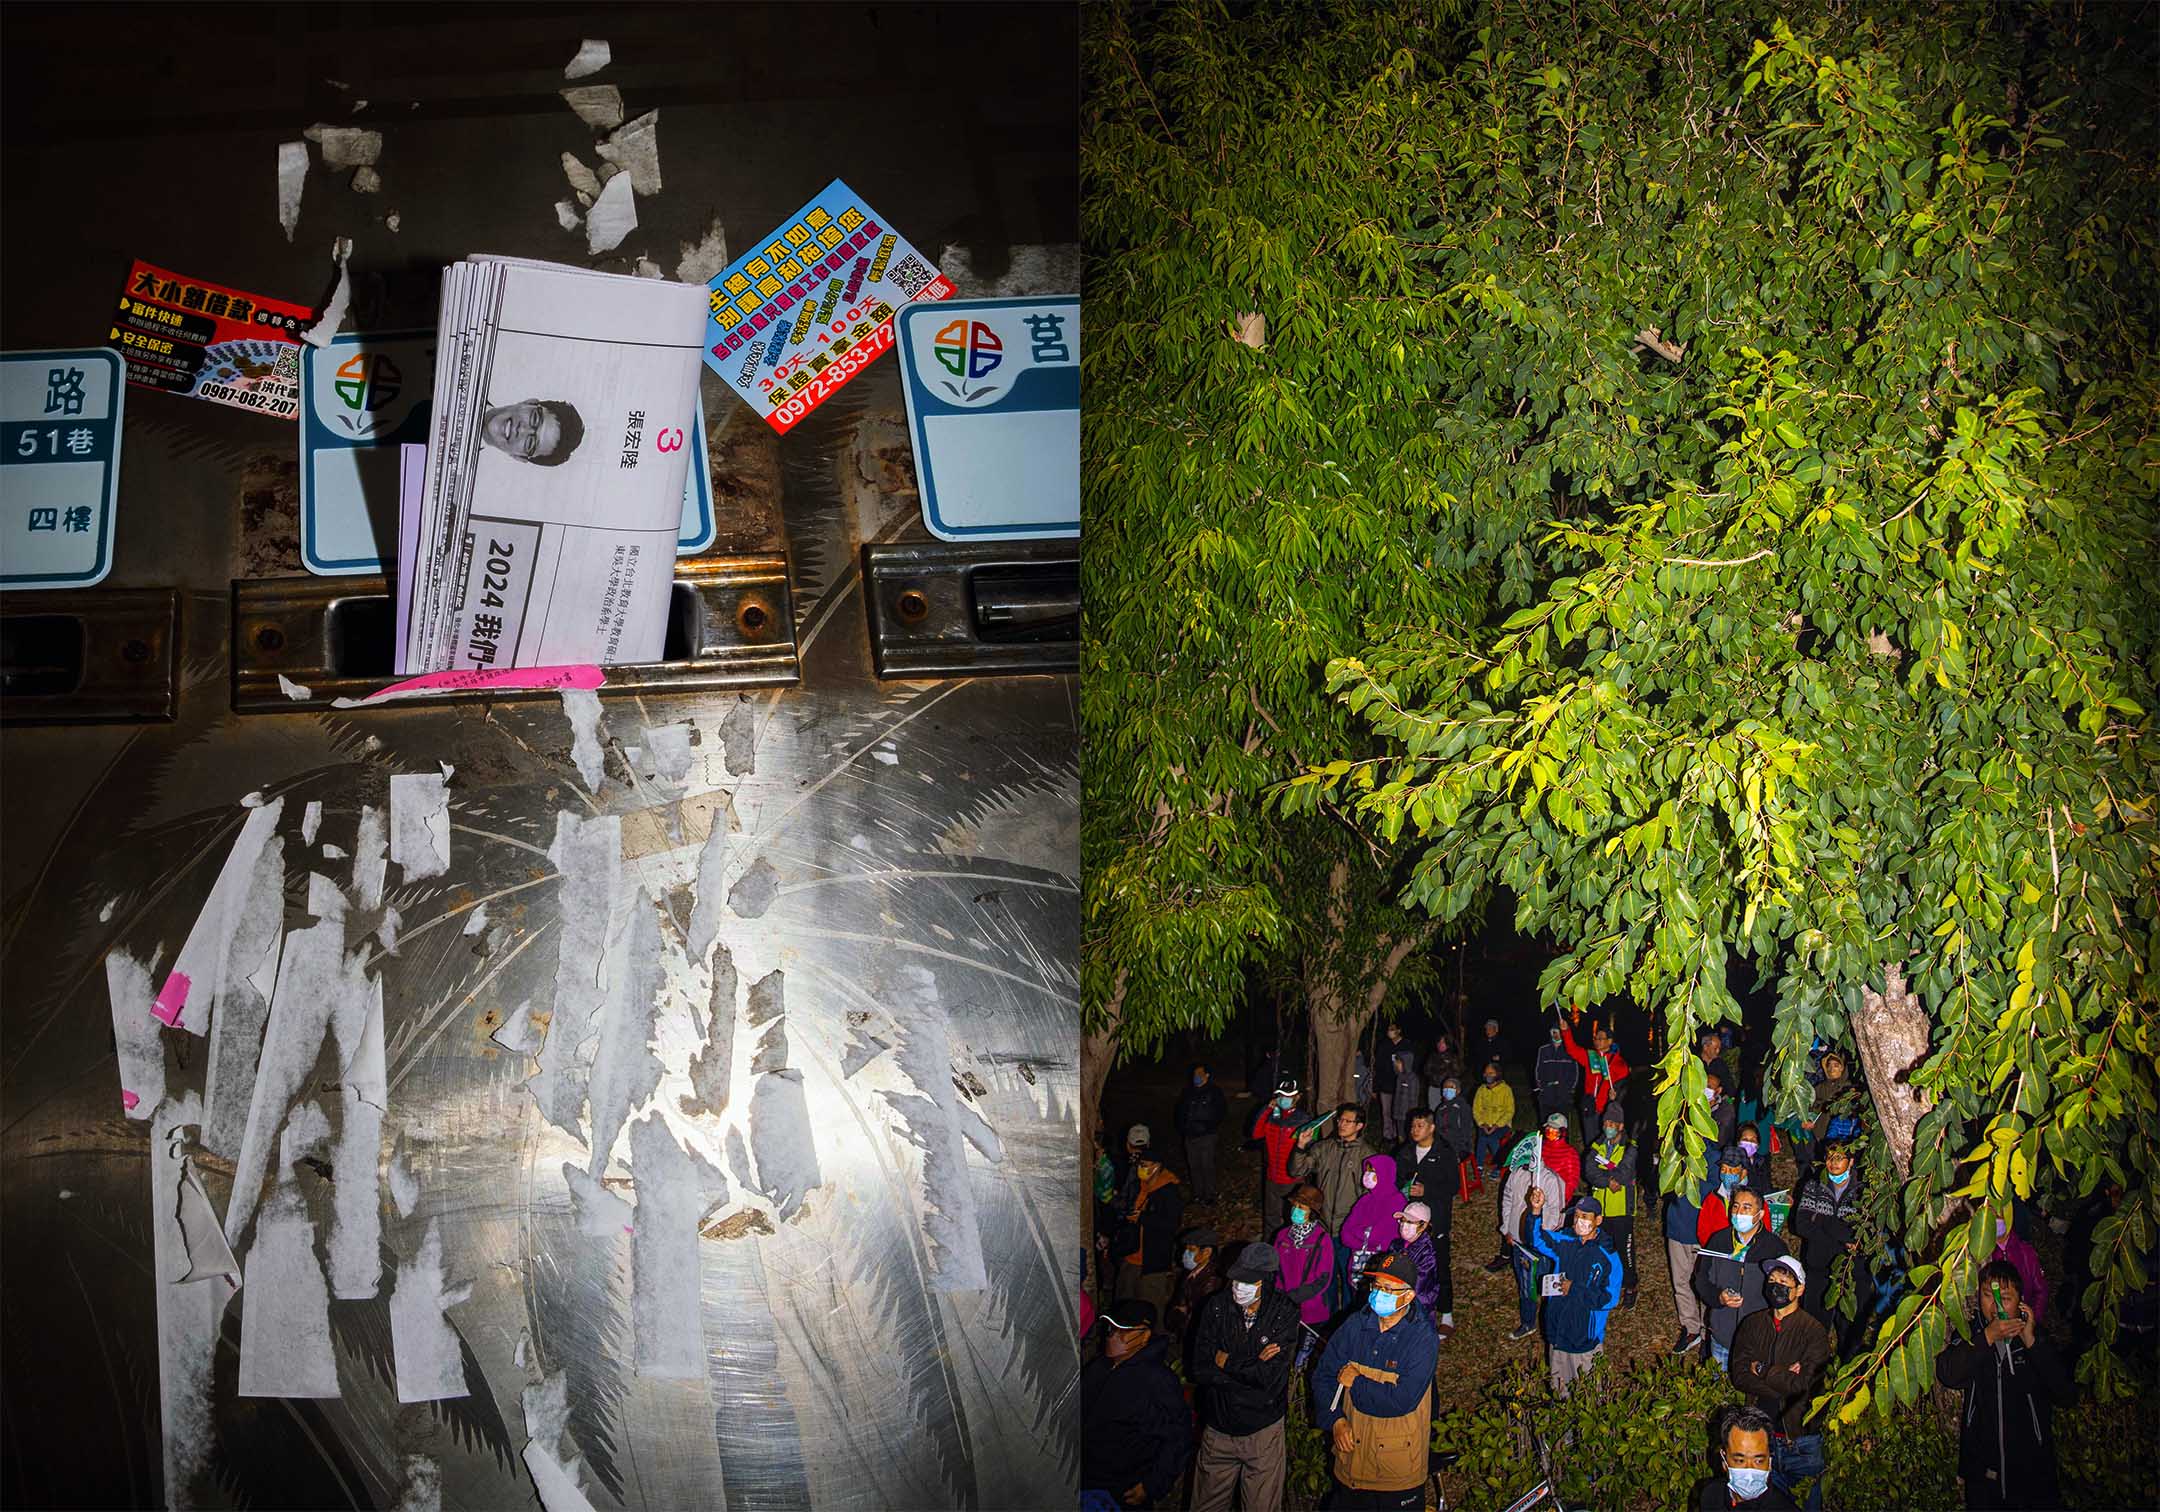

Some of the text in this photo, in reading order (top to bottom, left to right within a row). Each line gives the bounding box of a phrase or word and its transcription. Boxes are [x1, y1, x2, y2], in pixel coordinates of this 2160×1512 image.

[709, 207, 832, 311] 生總有不如意
[715, 207, 866, 331] 別讓高利拖垮您
[131, 271, 305, 330] 大小額借款 週轉免
[122, 332, 174, 355] 安全保密
[1022, 313, 1070, 364] 莒
[737, 341, 767, 389] 免押免保
[44, 367, 86, 416] 路
[200, 382, 297, 414] 0987-082-207
[18, 429, 94, 456] 51巷
[619, 409, 646, 470] 張宏陸
[656, 427, 683, 454] 3
[29, 506, 91, 532] 四樓
[482, 538, 513, 610] 2024
